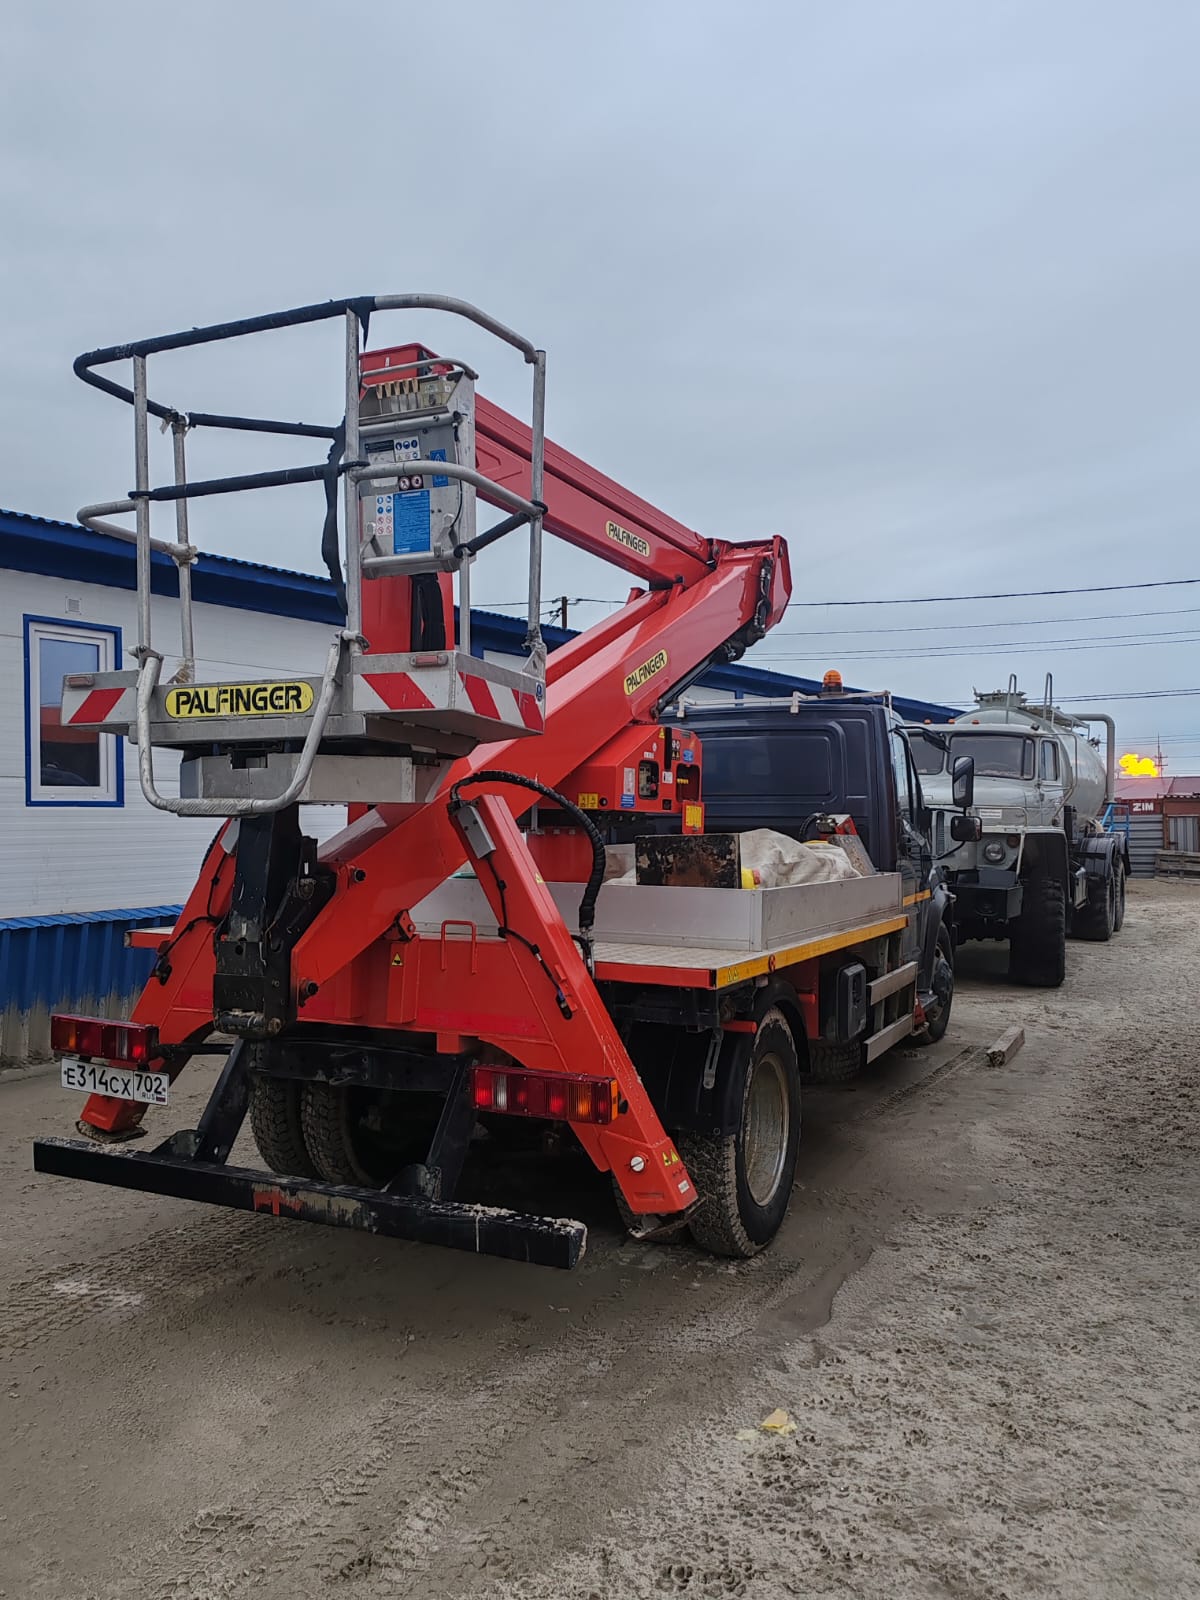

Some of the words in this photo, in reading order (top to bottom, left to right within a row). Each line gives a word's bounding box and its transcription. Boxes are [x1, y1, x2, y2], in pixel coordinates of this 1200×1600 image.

[608, 522, 647, 555] PALFINGER
[626, 652, 665, 693] PALFINGER
[175, 685, 302, 715] PALFINGER
[1132, 802, 1154, 811] ZIM
[134, 1073, 162, 1095] 702
[142, 1092, 155, 1100] RUS
